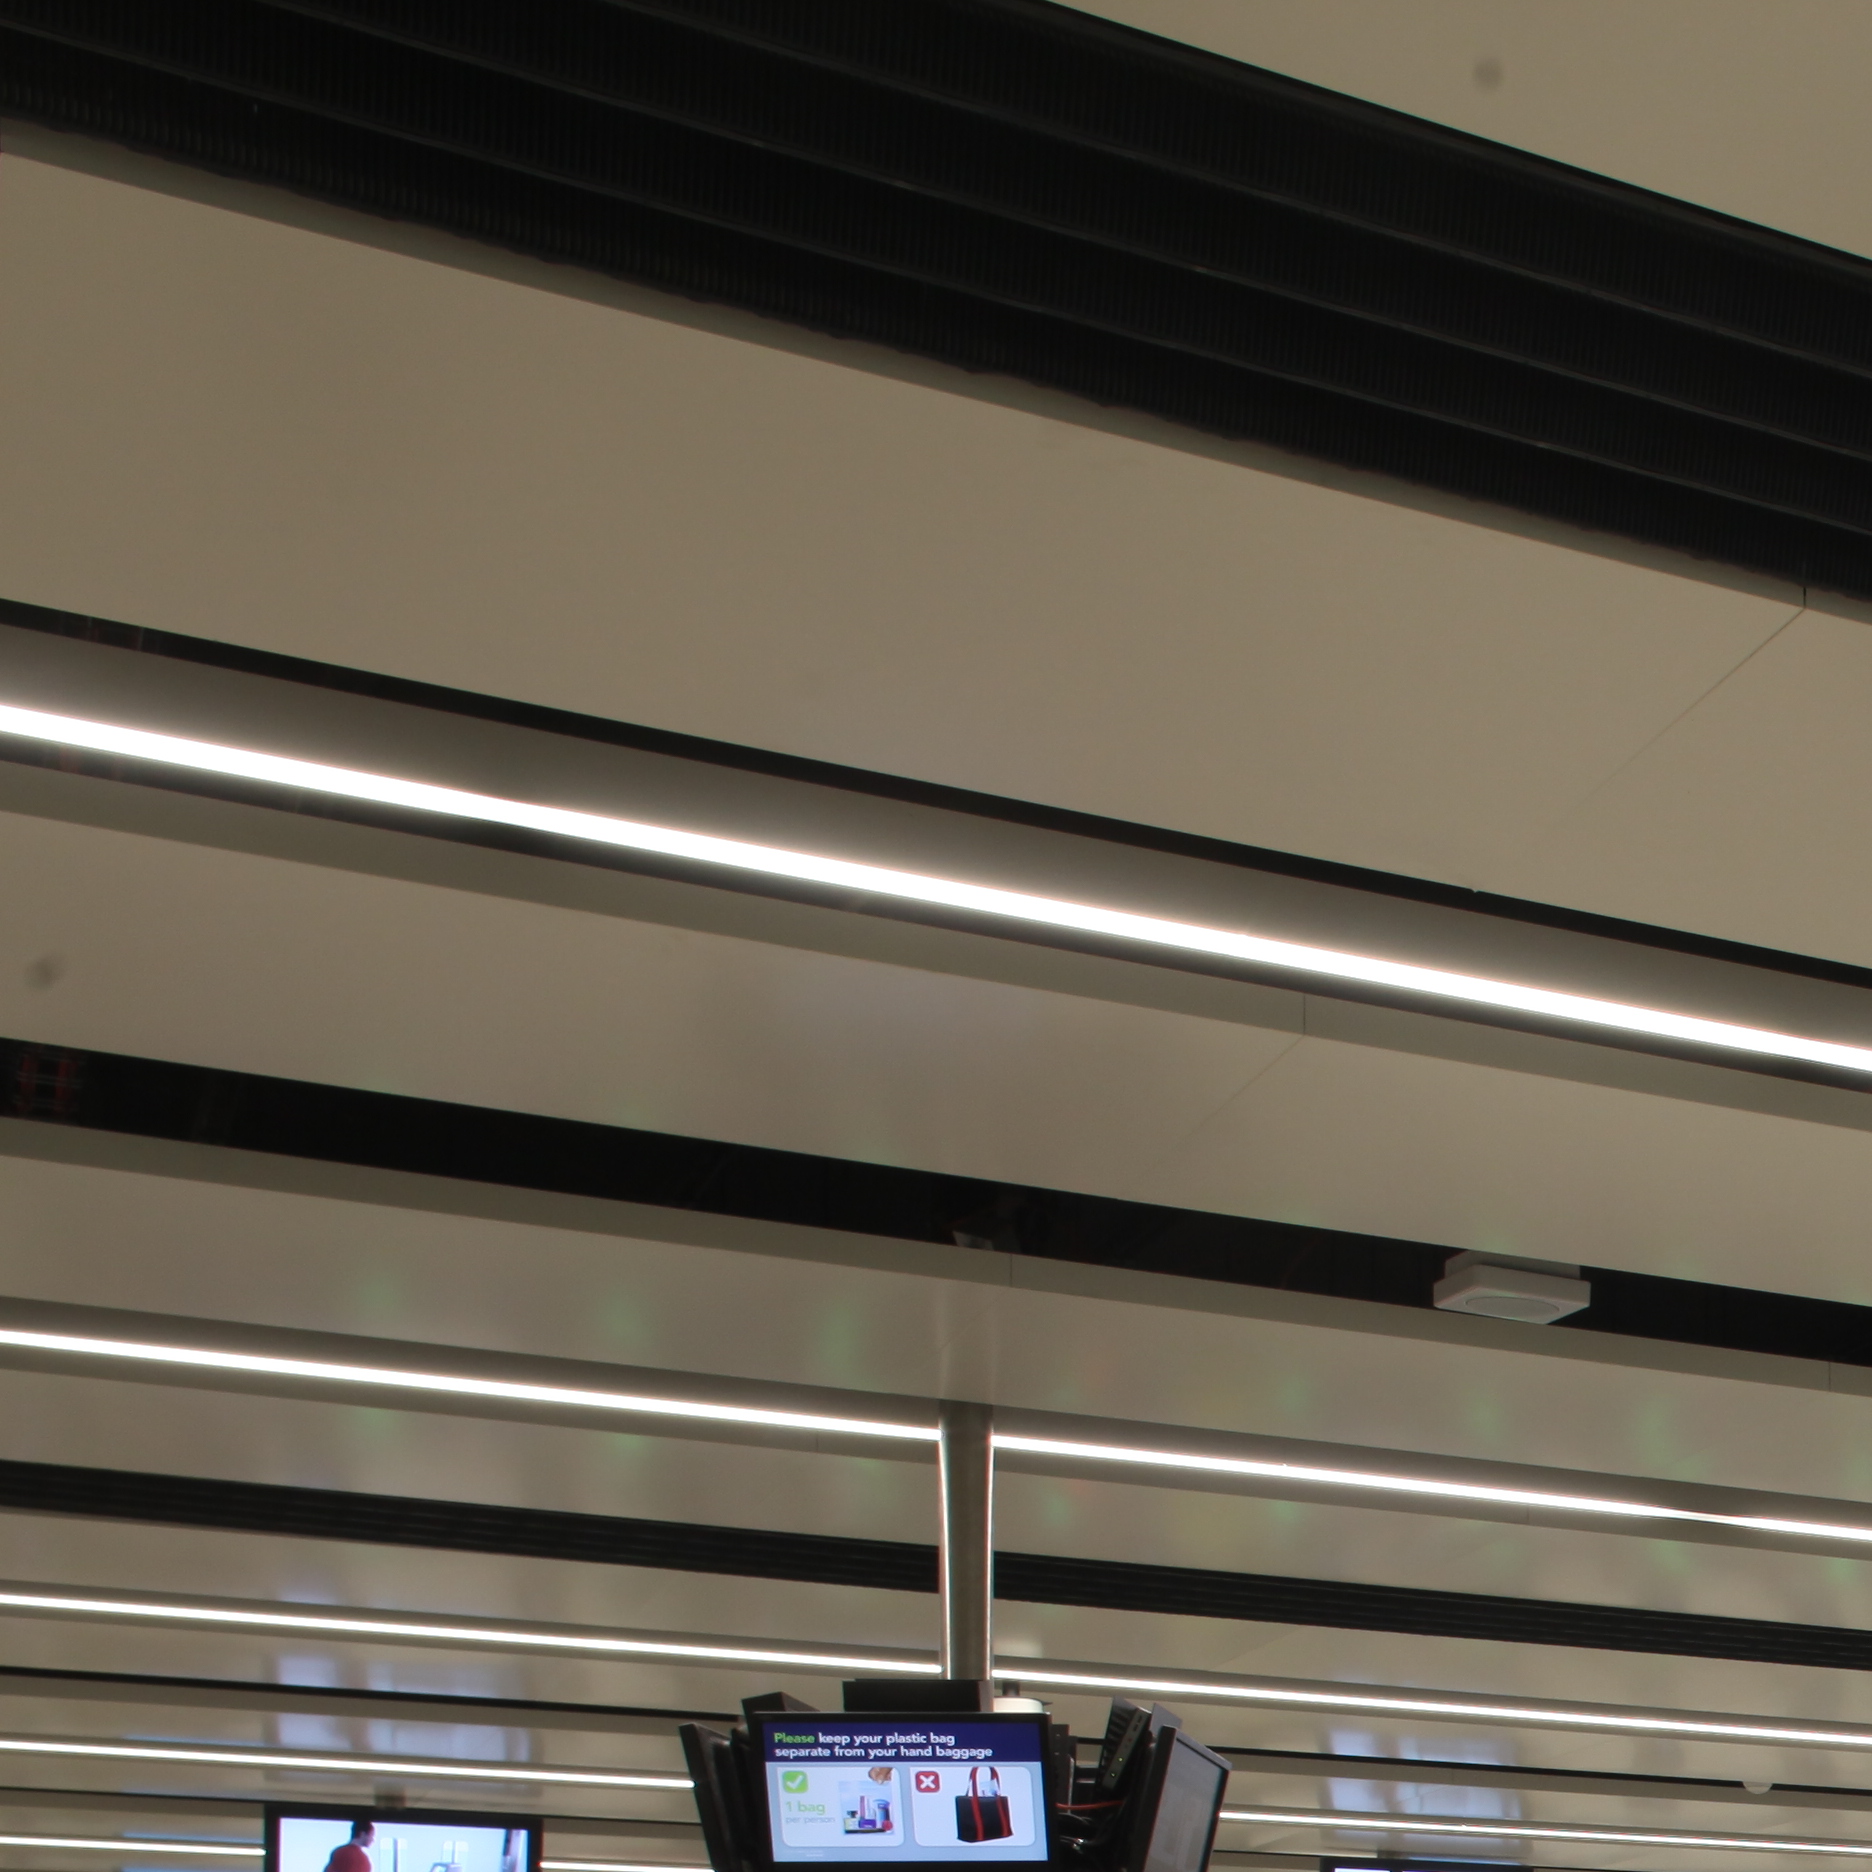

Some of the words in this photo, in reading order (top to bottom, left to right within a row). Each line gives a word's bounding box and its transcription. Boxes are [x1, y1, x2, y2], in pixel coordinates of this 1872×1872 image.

[774, 1733, 815, 1744] Please
[818, 1733, 850, 1745] keep
[854, 1734, 883, 1746] your
[886, 1732, 927, 1746] plastic
[930, 1732, 955, 1745] bag
[775, 1747, 830, 1759] separate
[834, 1746, 865, 1757] from
[868, 1749, 897, 1760] your
[901, 1746, 933, 1757] hand
[936, 1746, 992, 1760] baggage
[786, 1801, 792, 1812] 1
[798, 1801, 825, 1815] bag
[785, 1817, 800, 1825] per
